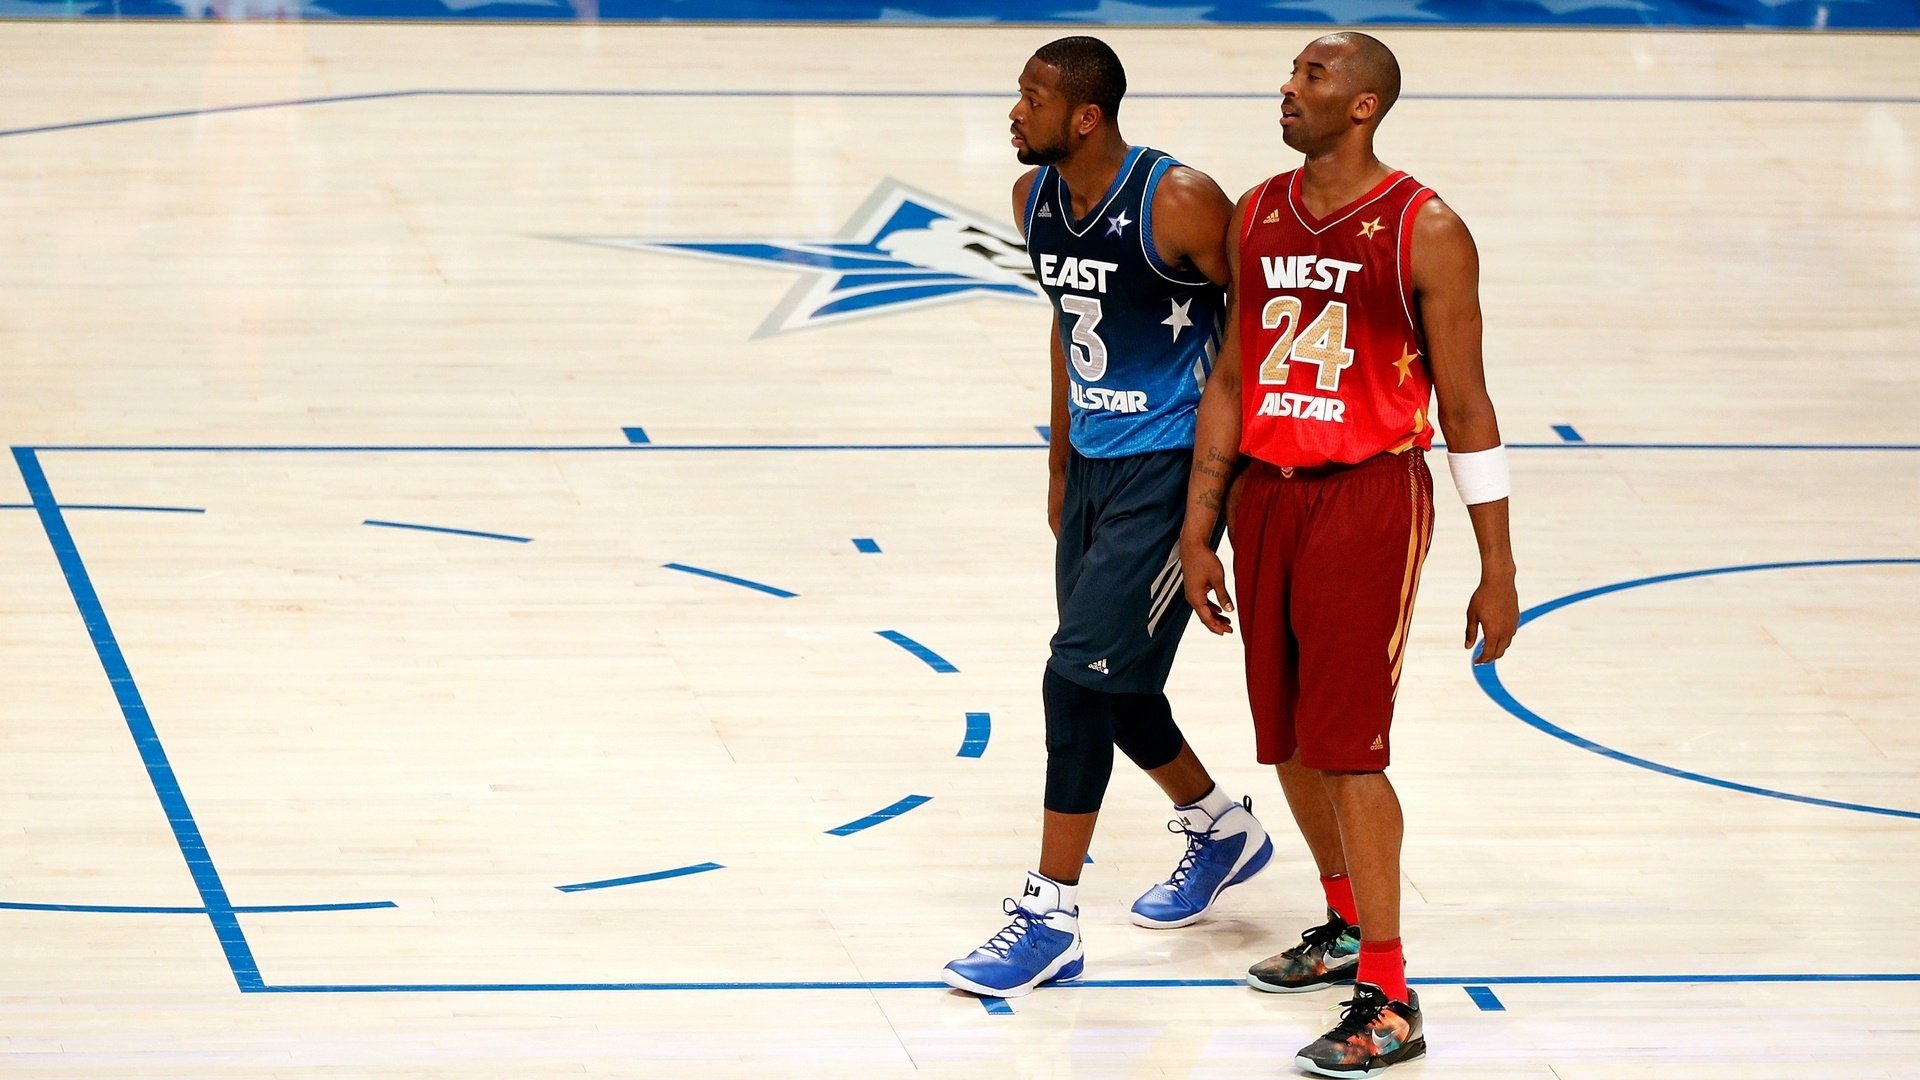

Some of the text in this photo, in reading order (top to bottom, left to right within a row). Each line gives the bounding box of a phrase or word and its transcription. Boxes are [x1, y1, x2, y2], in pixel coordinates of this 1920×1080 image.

[1040, 253, 1119, 293] EAST
[1260, 255, 1363, 294] WEST
[1060, 294, 1108, 382] 3
[1258, 295, 1355, 392] 24
